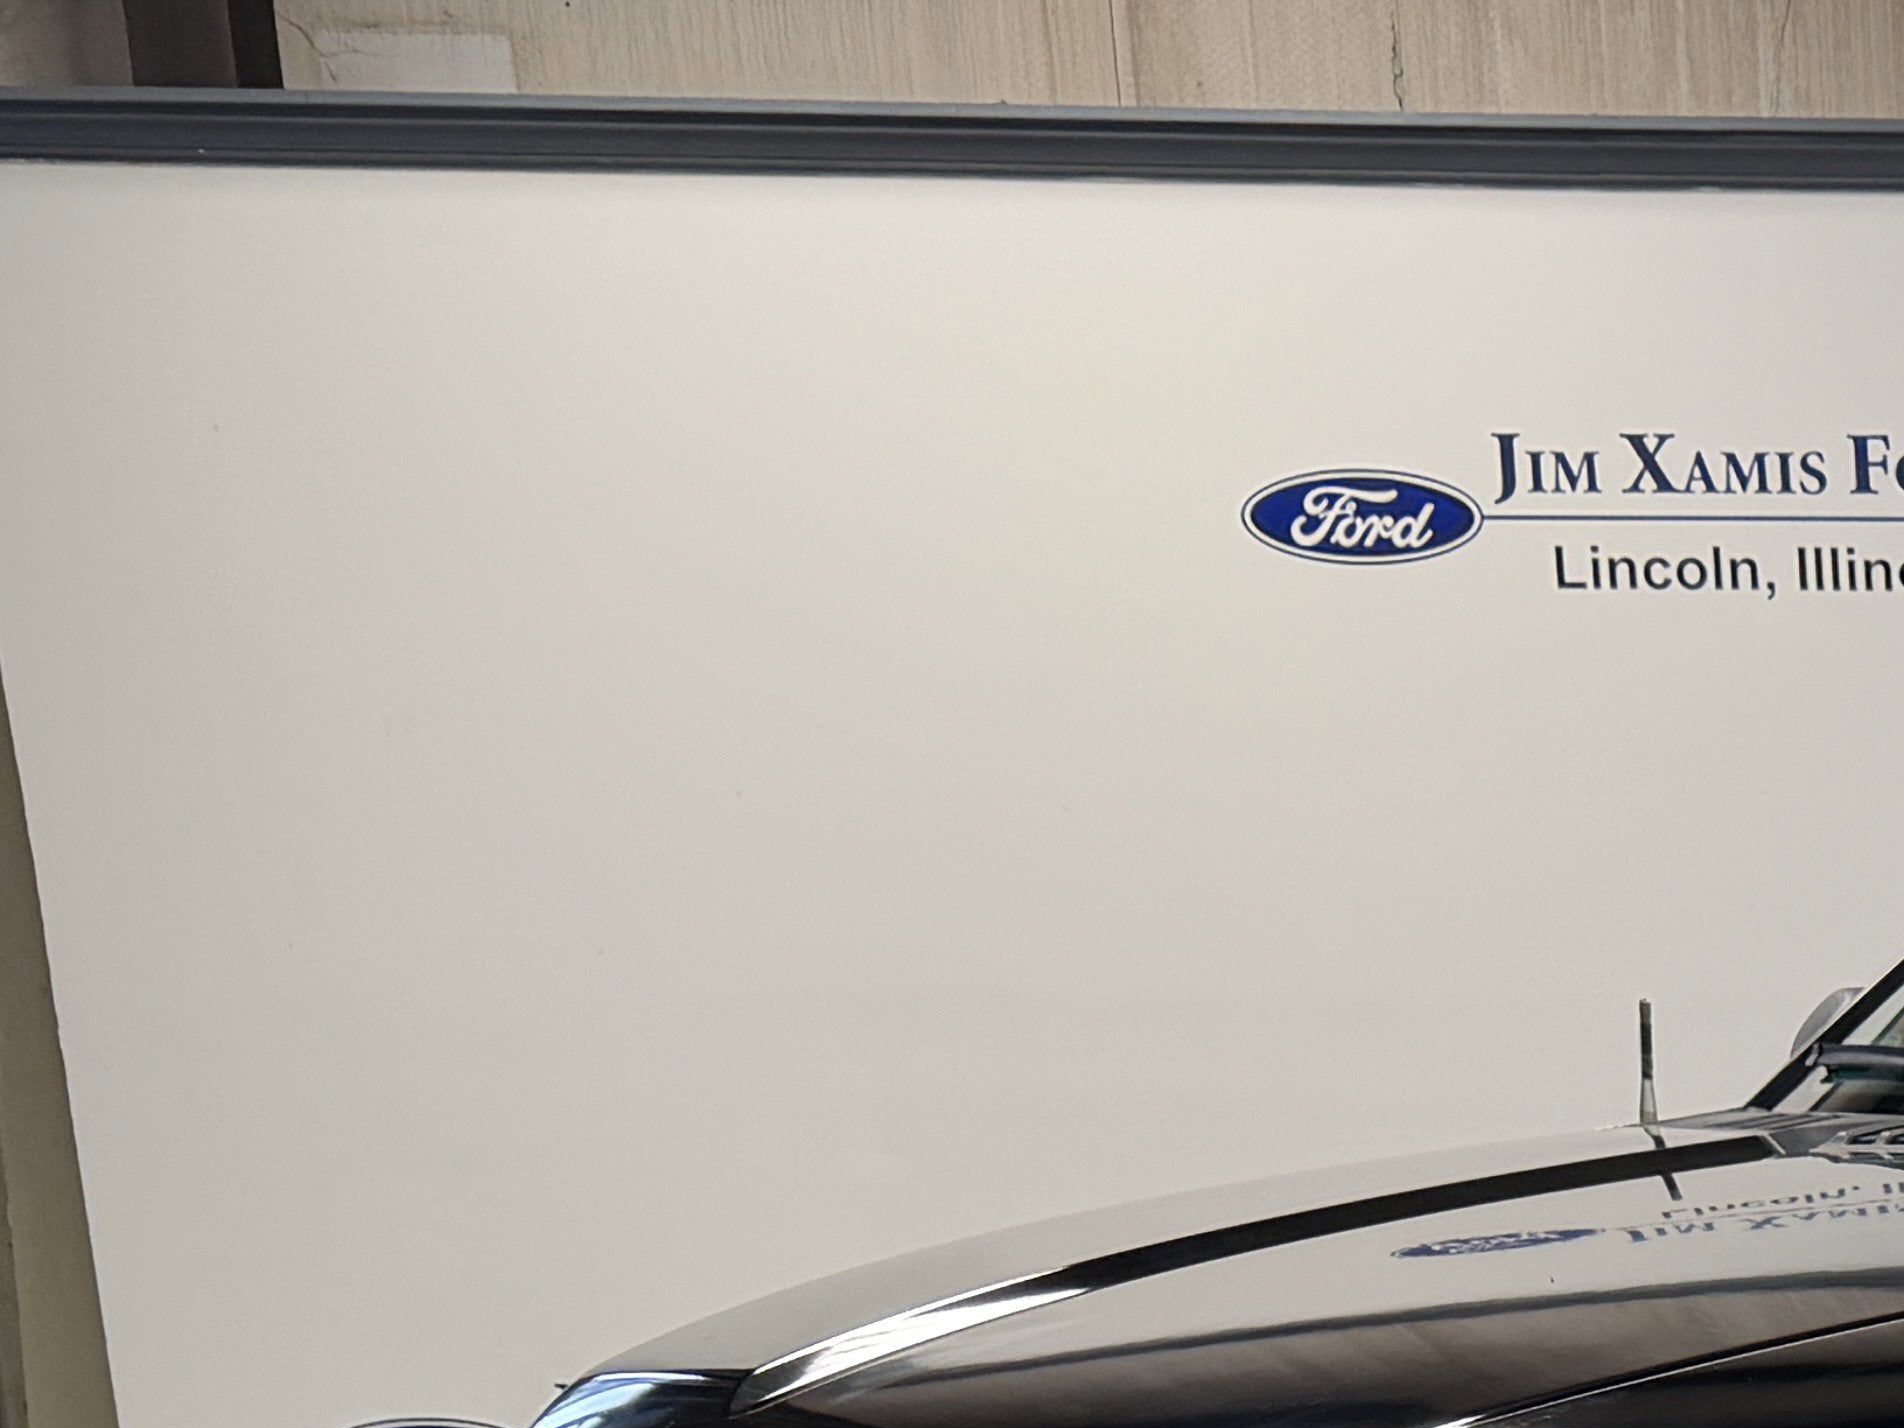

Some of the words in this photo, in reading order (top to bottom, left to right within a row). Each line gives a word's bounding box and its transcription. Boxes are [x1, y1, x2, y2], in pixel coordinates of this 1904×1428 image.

[1491, 432, 1601, 504] JIM
[1619, 432, 1828, 497] XAMIS
[1290, 483, 1435, 551] Ford
[1555, 545, 1777, 599] Lincoln,
